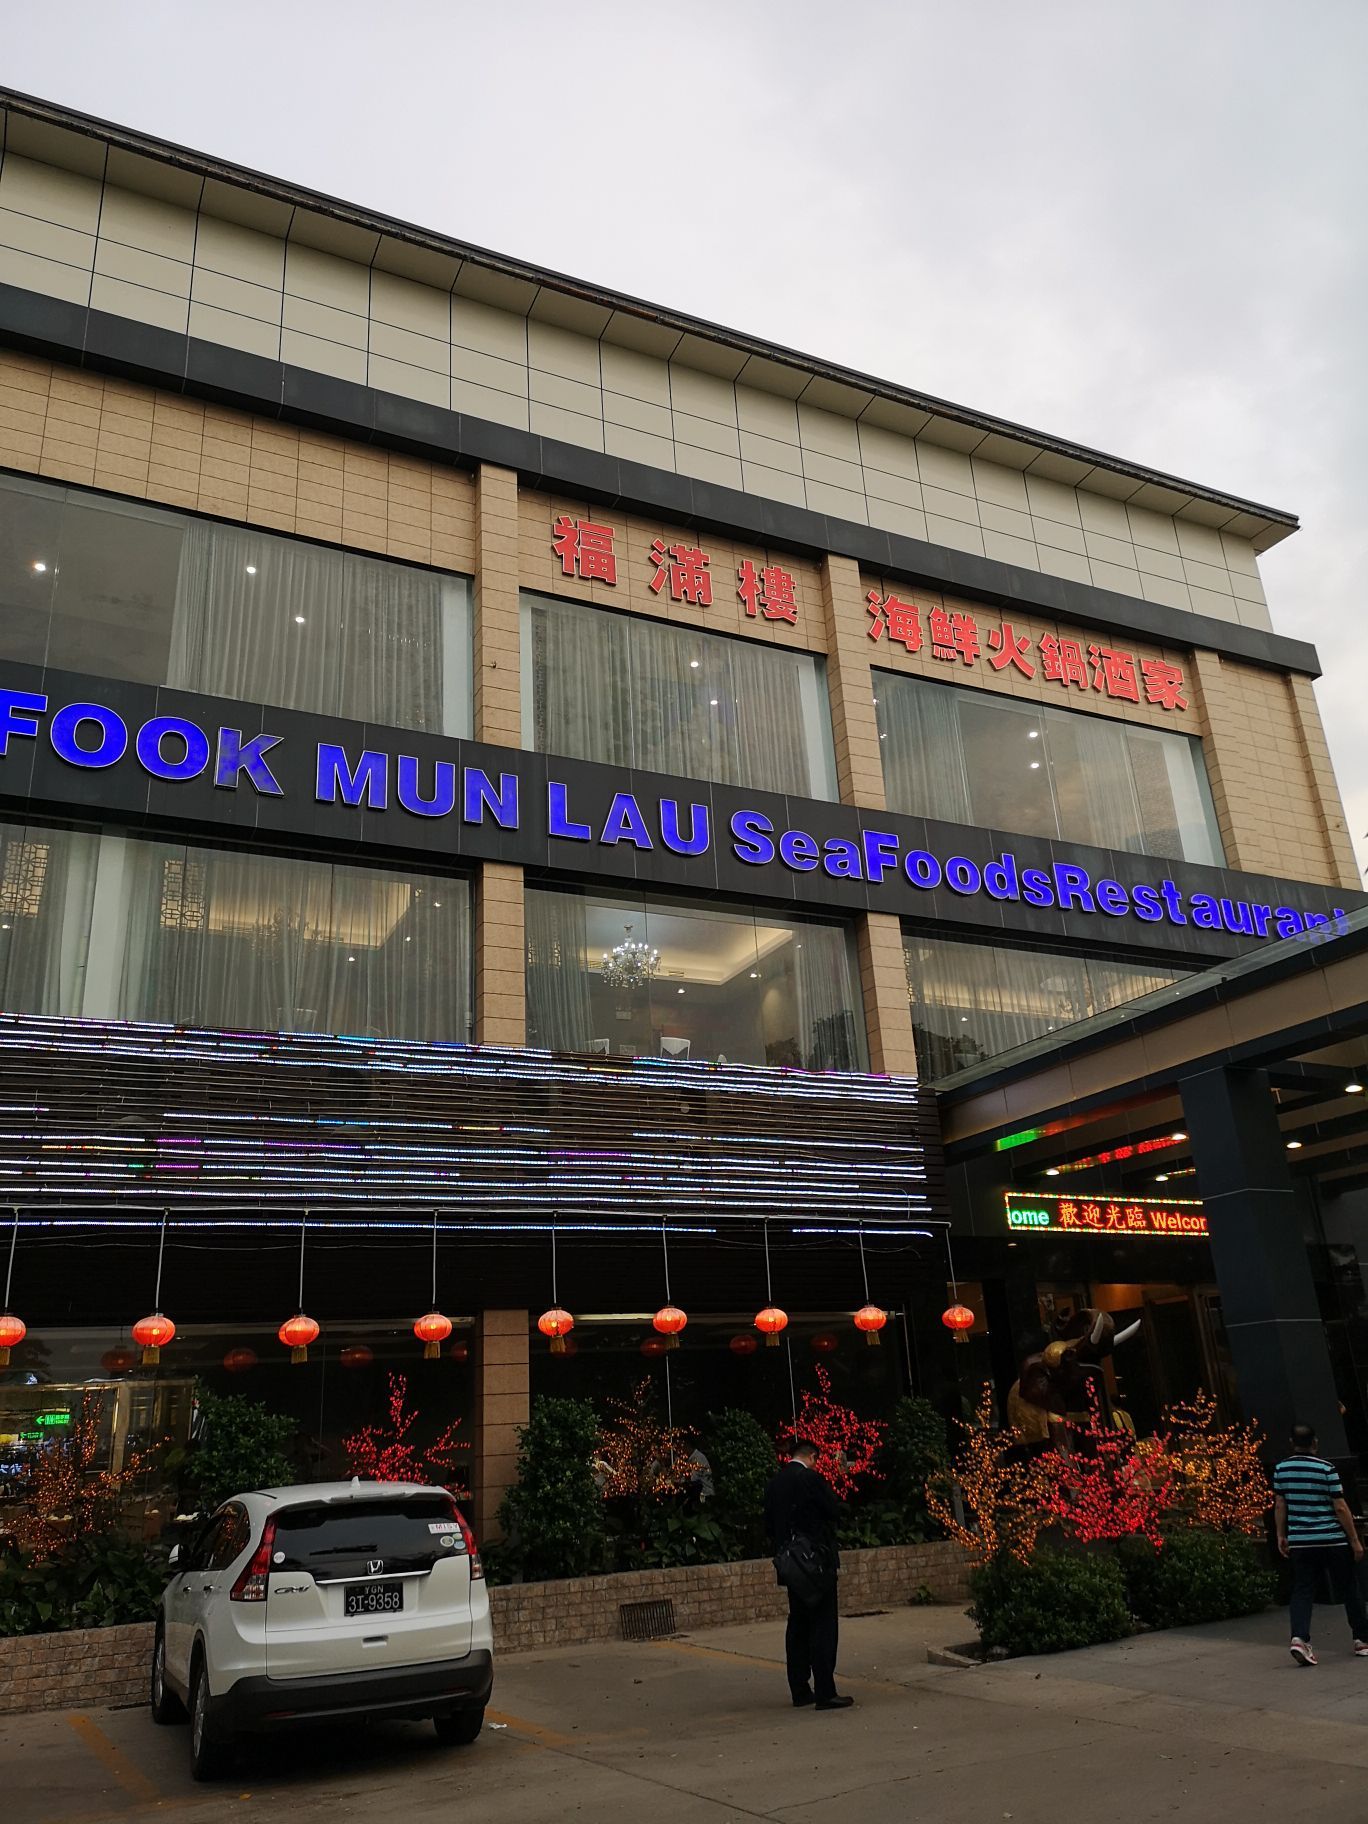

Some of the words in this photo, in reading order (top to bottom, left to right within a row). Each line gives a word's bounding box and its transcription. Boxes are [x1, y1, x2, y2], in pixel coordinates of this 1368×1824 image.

[552, 515, 799, 625] 福滿樓
[866, 589, 1189, 711] 海鮮火鍋酒家
[0, 688, 285, 797] FOOK
[316, 742, 519, 830] MUN
[547, 782, 711, 856] LAU
[1058, 1201, 1147, 1229] 歡迎光臨
[364, 1584, 385, 1595] YGN
